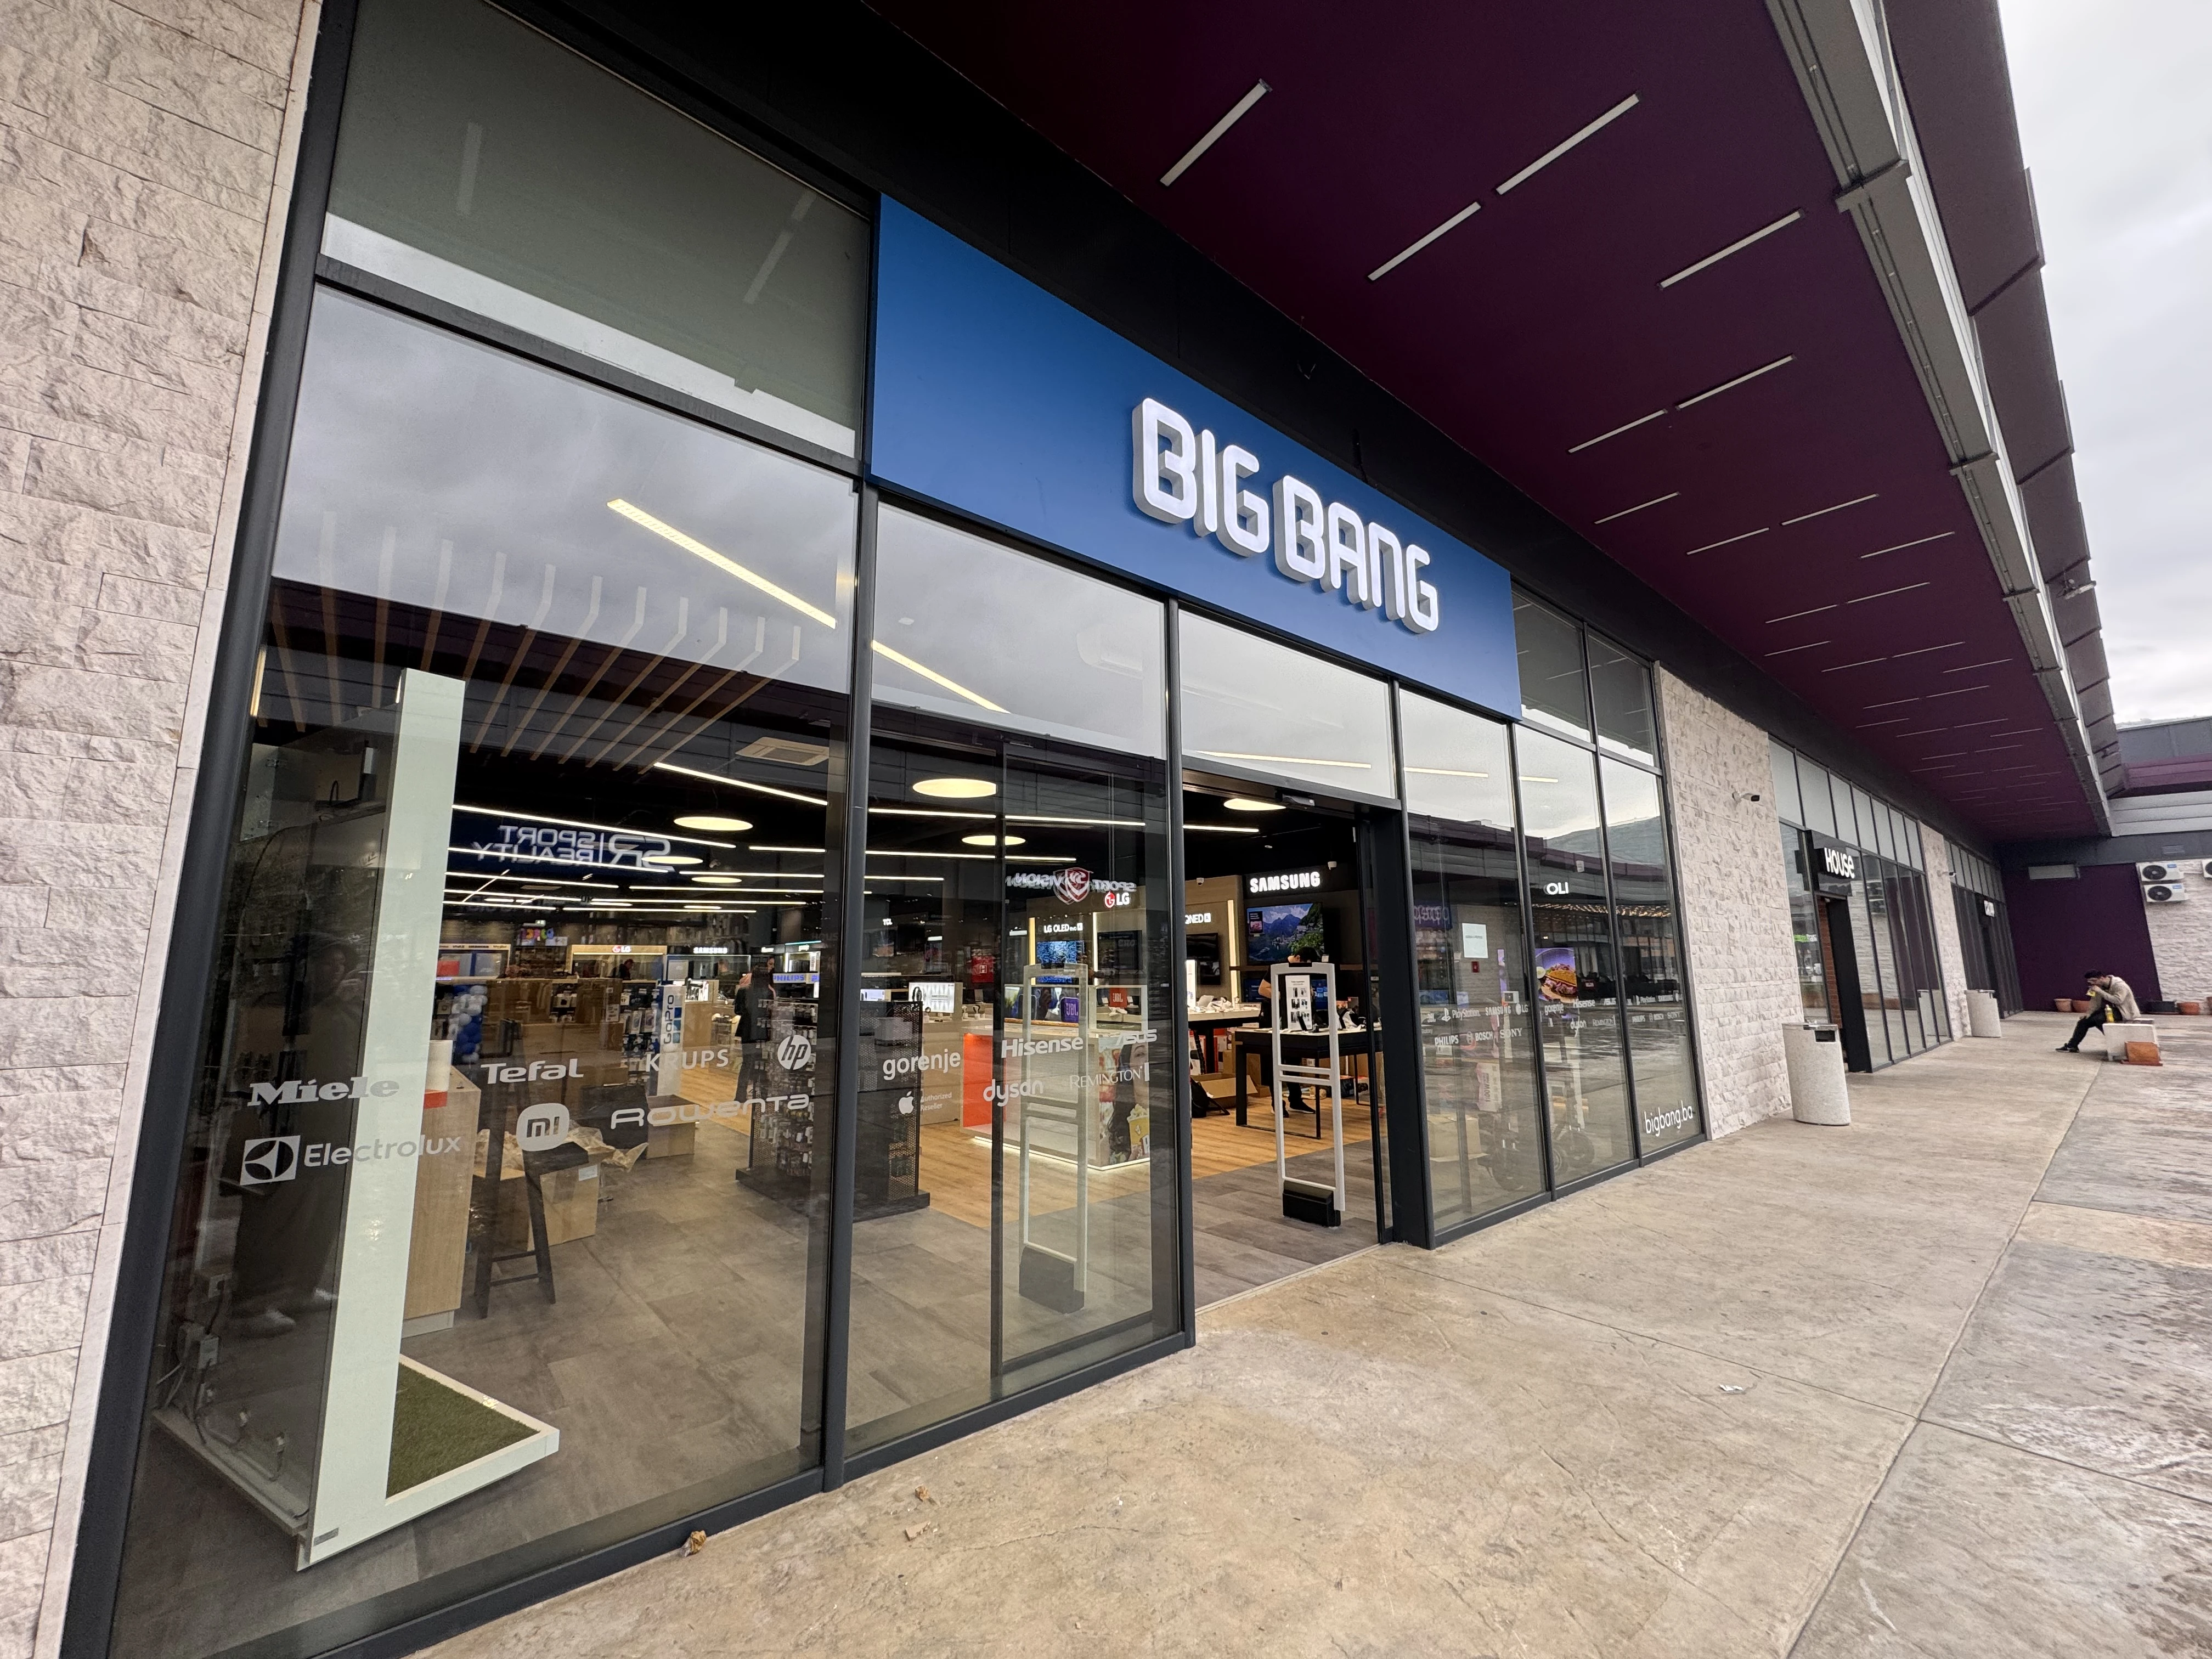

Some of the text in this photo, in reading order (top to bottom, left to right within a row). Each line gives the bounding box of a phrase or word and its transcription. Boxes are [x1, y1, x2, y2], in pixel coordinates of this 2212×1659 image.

[1132, 398, 1439, 634] BIG BANG
[1250, 871, 1321, 893] SAMSUNG
[1116, 892, 1130, 906] LG
[1043, 925, 1052, 933] LG
[1053, 924, 1070, 933] OLED
[1113, 992, 1124, 1003] JBL
[663, 994, 674, 1044] GoPro
[1065, 1002, 1079, 1016] JBL
[1452, 1008, 1481, 1021] PlayStation
[1485, 1005, 1511, 1016] SAMSUNG
[1001, 1029, 1158, 1059] Hisense ASUS
[1435, 1028, 1523, 1047] PHILIPS BOSCH SONY
[481, 1058, 584, 1085] Tefal
[883, 1048, 961, 1081] gorenje
[1070, 1068, 1141, 1090] REMINGTON
[246, 1076, 400, 1107] Miele
[920, 1091, 952, 1103] Authorized
[983, 1079, 1045, 1107] dyson
[920, 1103, 943, 1112] Reseller
[1644, 1099, 1694, 1137] bigbang.ba
[303, 1134, 462, 1168] Electrolux
